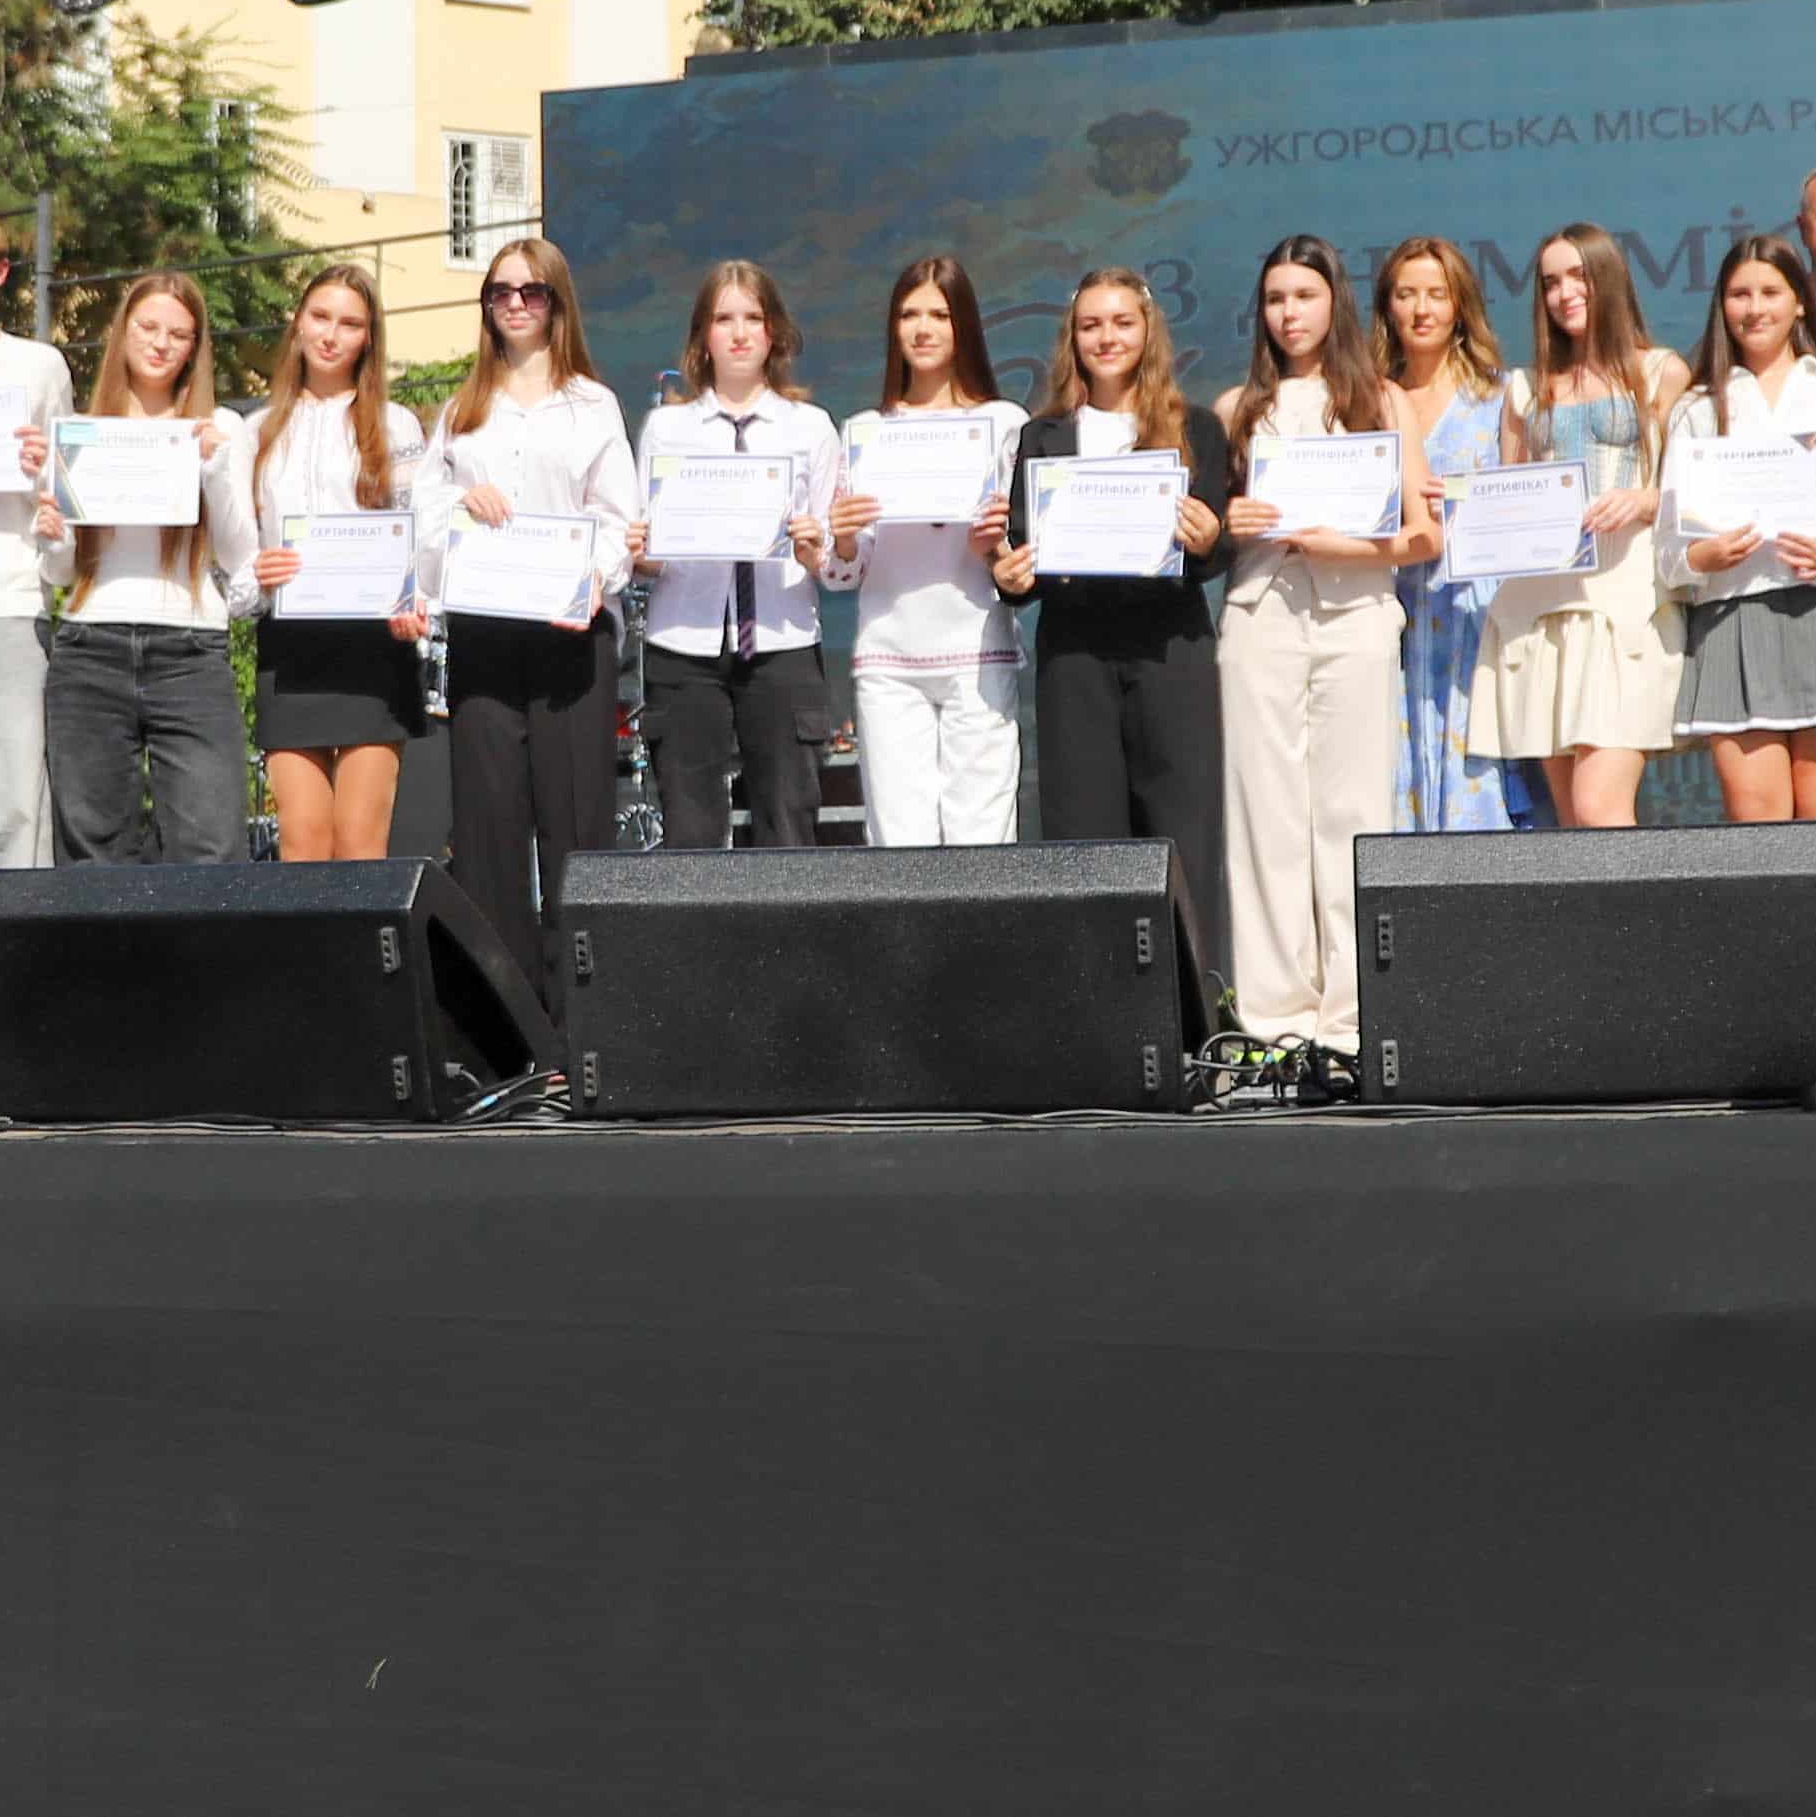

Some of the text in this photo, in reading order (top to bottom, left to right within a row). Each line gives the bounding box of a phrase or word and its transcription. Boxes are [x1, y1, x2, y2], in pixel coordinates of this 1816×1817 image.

[1214, 113, 1579, 169] УЖГОРОДСЬКА
[1593, 98, 1776, 144] МІСЬКА
[1070, 484, 1148, 497] СЕРТИФІКАТ
[1472, 479, 1550, 496] СЕРТИФІКАТ
[311, 526, 382, 538] СЕРТИФІКАТ
